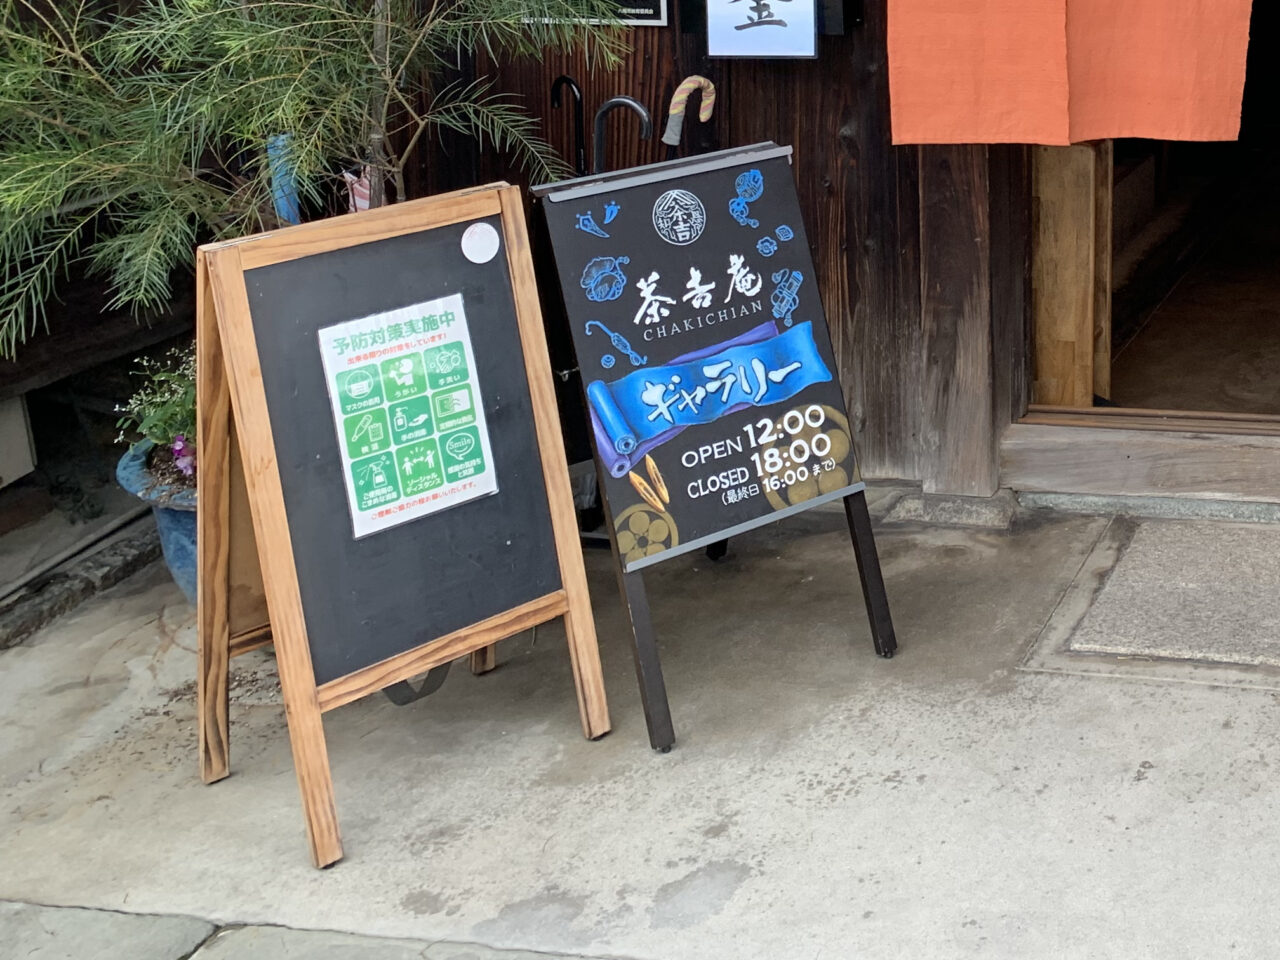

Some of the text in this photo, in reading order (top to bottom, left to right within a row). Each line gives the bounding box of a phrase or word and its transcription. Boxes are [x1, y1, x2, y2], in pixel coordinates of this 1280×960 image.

[633, 254, 763, 325] 茶吉庵
[643, 300, 763, 341] CHAKICHIAN
[332, 310, 456, 356] 予防対策実施中
[641, 358, 802, 424] ギャラリー
[681, 404, 825, 468] OPEN 12:00
[687, 433, 832, 499] CLOSED 18:00
[762, 466, 809, 493] 16:00
